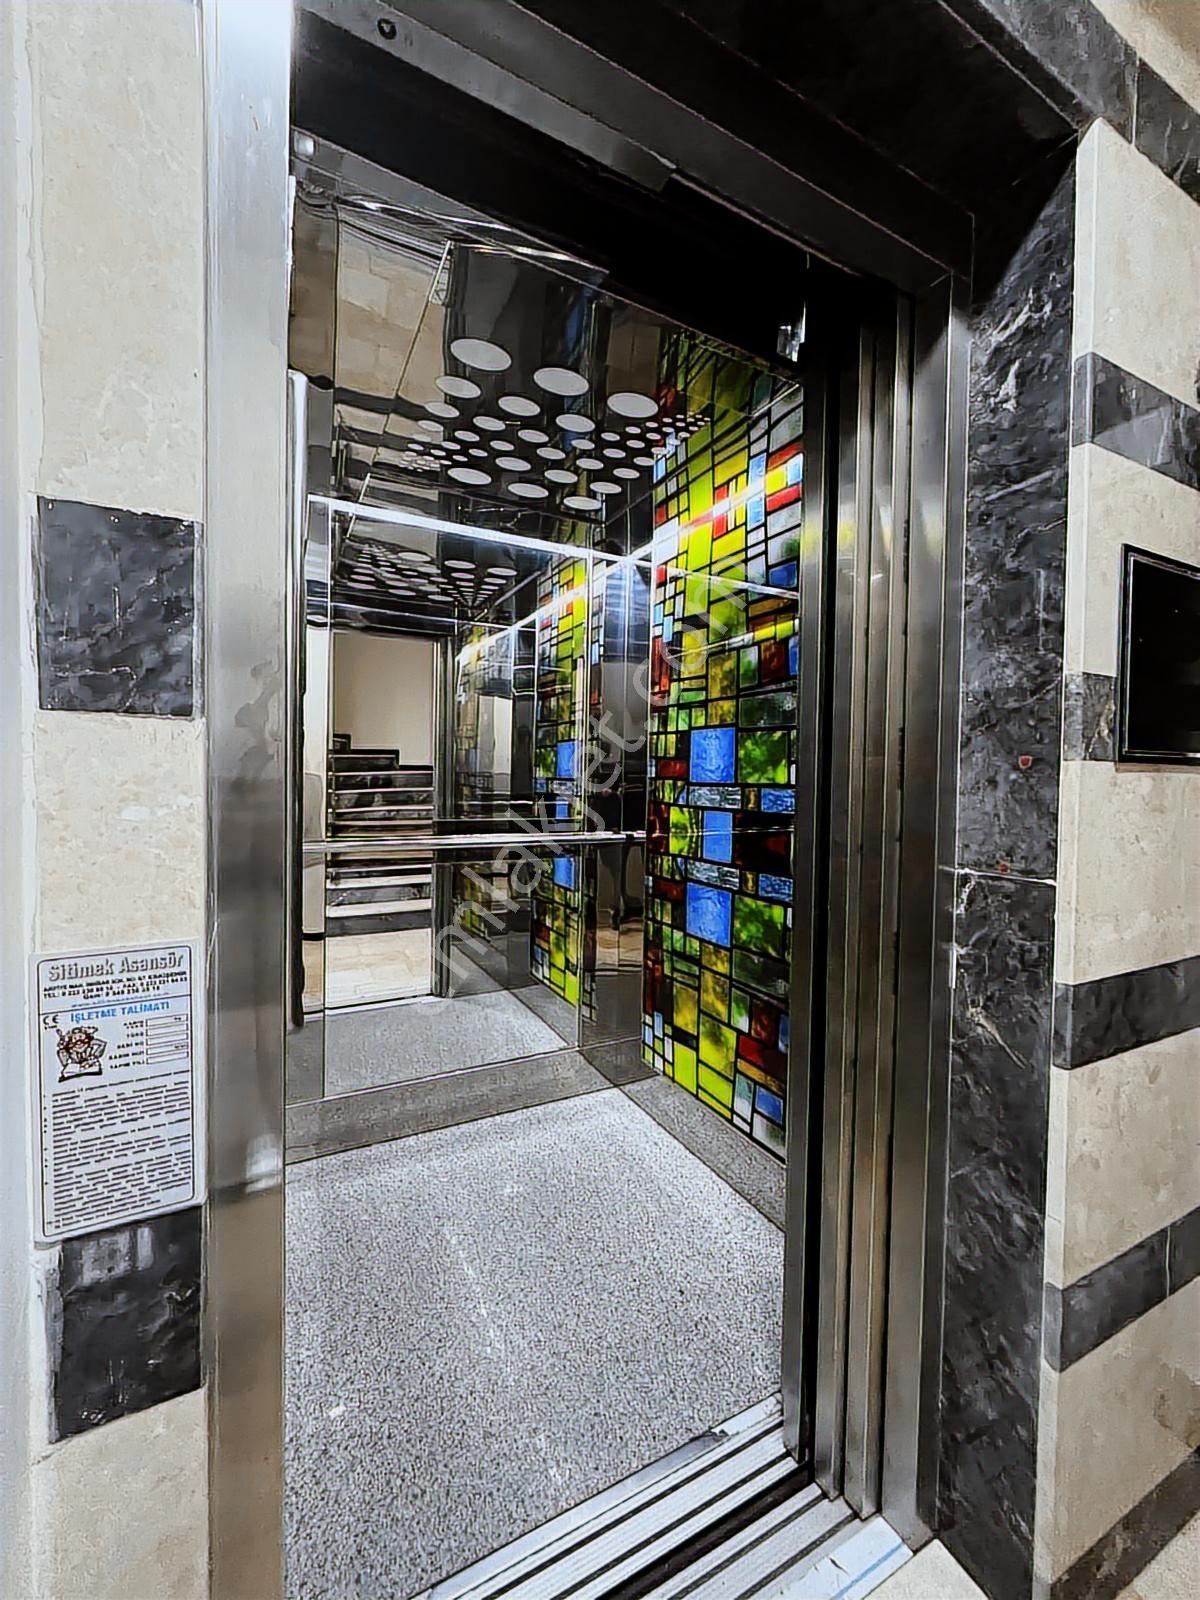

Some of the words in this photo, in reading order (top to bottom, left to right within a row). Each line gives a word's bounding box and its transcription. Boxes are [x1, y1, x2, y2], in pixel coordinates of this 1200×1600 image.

[119, 952, 183, 974] Asansör
[70, 1007, 117, 1024] İŞLETME
[120, 1001, 169, 1014] TALİMATI
